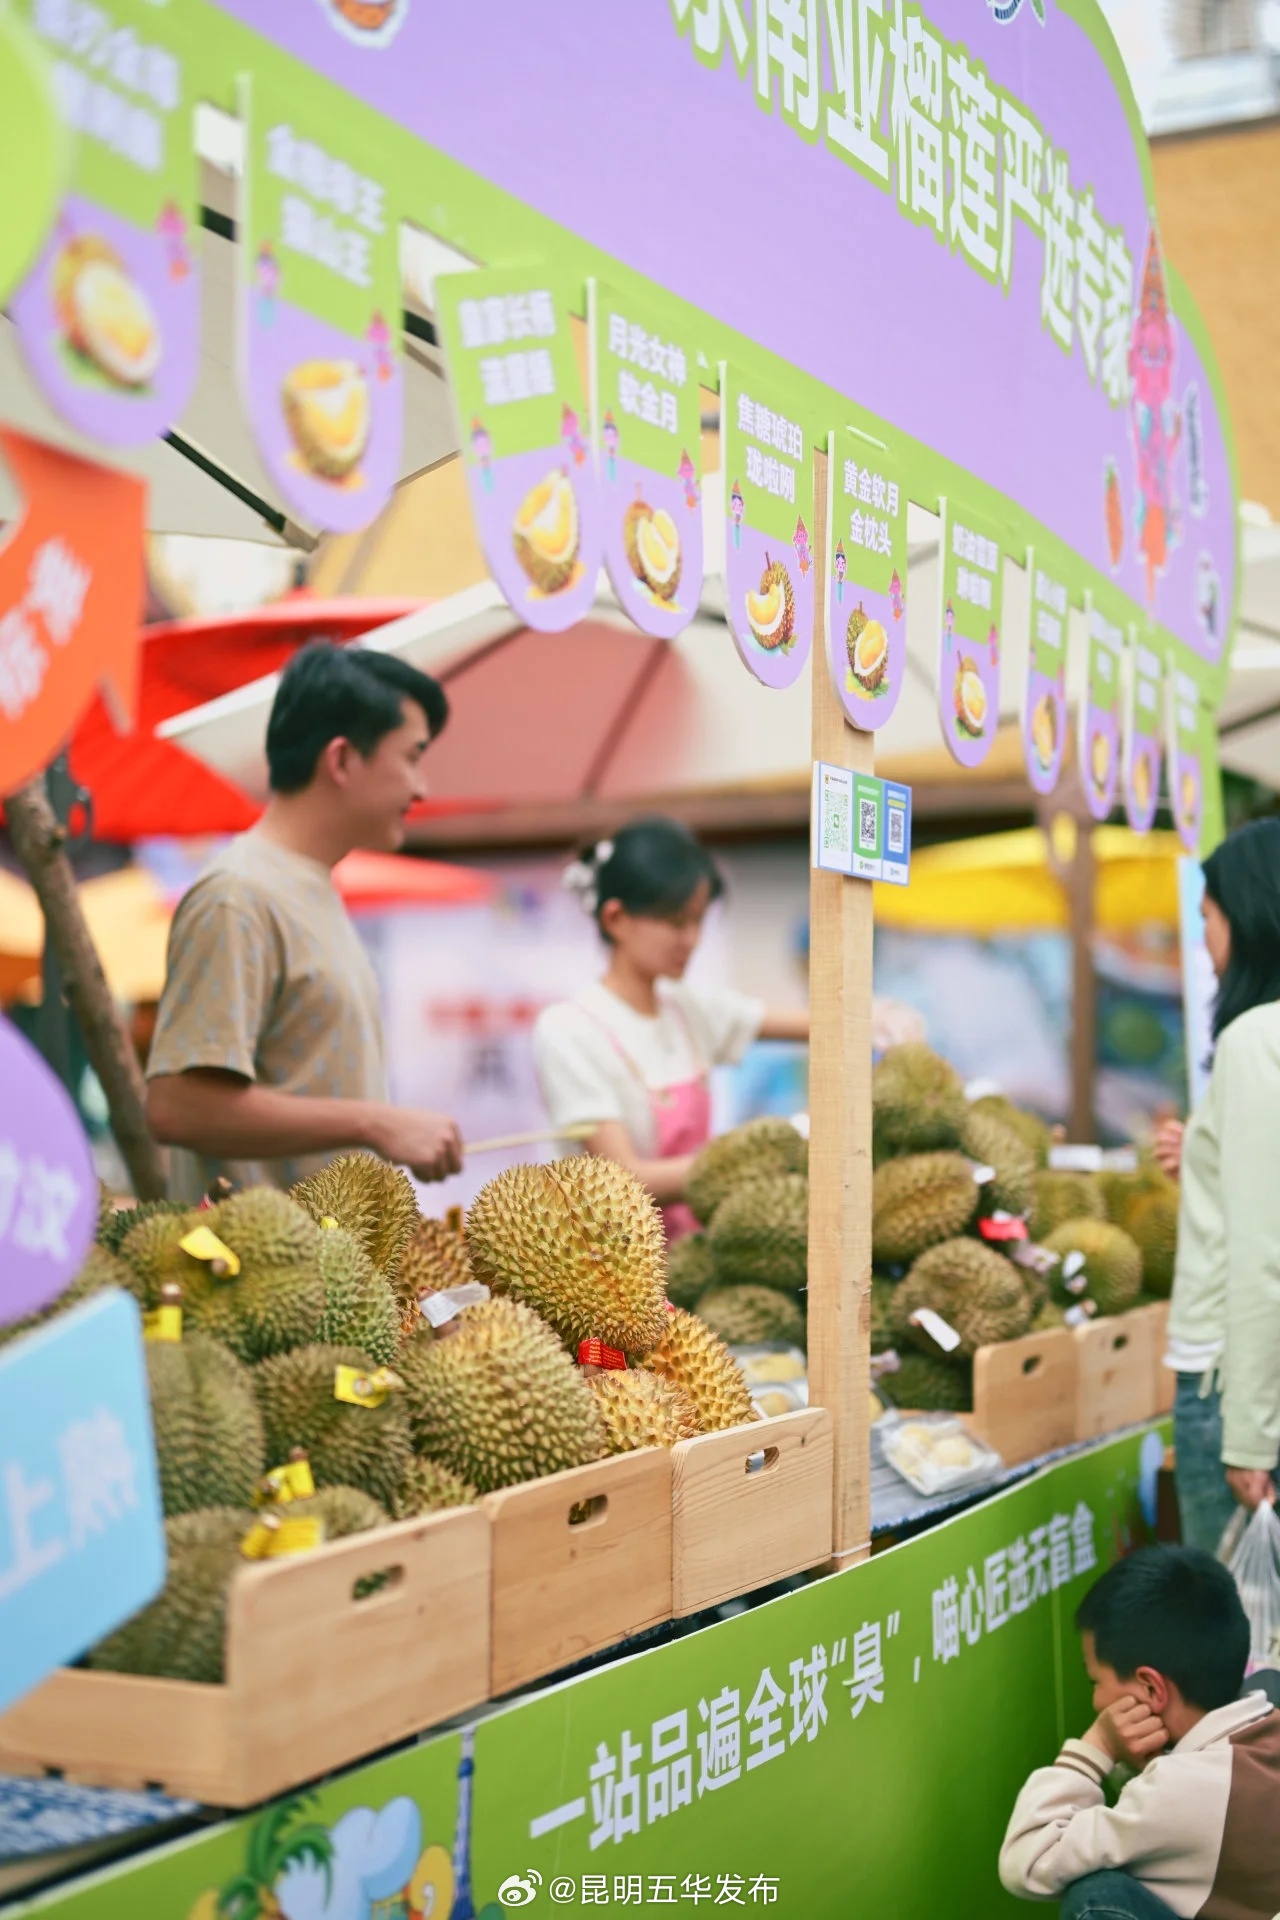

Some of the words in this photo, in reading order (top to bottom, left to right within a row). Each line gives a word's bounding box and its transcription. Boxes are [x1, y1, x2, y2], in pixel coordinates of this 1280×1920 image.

[737, 392, 803, 463] 焦糖琥珀
[844, 458, 899, 518] 黄金软月
[850, 508, 892, 557] 金枕头
